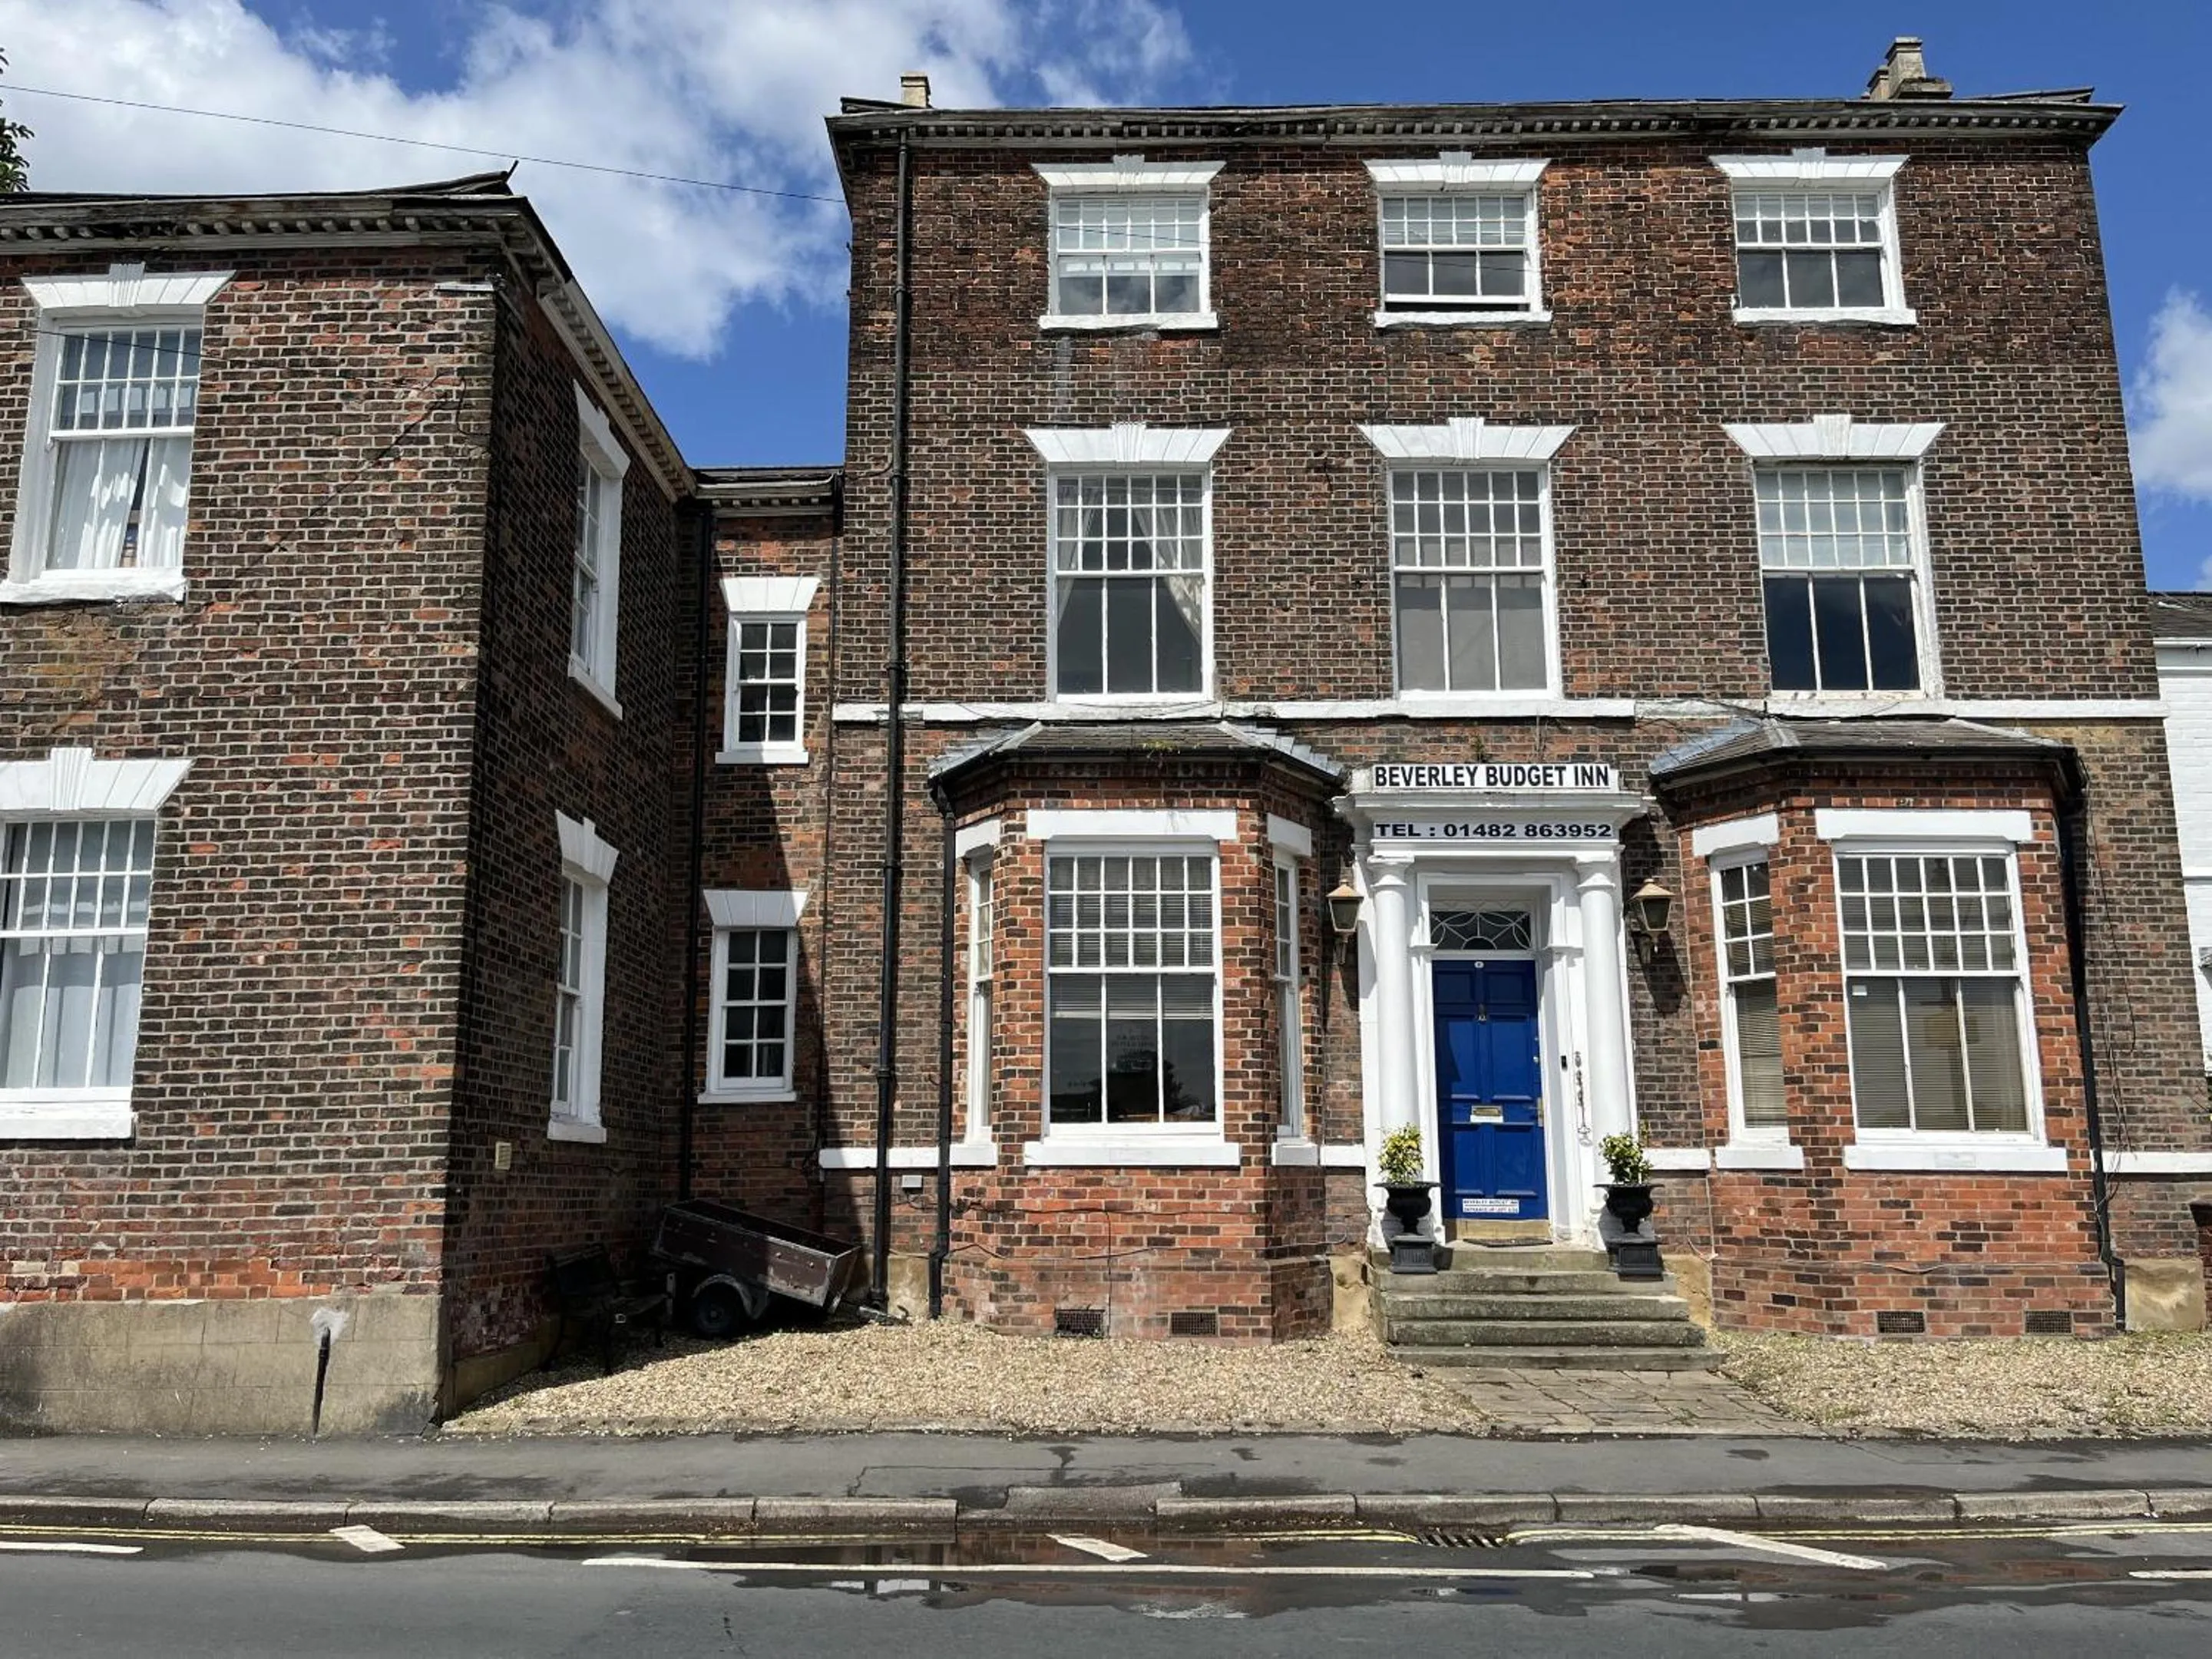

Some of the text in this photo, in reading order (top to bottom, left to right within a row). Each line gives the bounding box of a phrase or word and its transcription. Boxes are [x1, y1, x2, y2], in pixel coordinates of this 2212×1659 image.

[1375, 765, 1609, 787] BEVERLEY BUDGET INN
[1375, 824, 1421, 837] TEL
[1443, 824, 1516, 837] 01482
[1524, 824, 1612, 837] 863952
